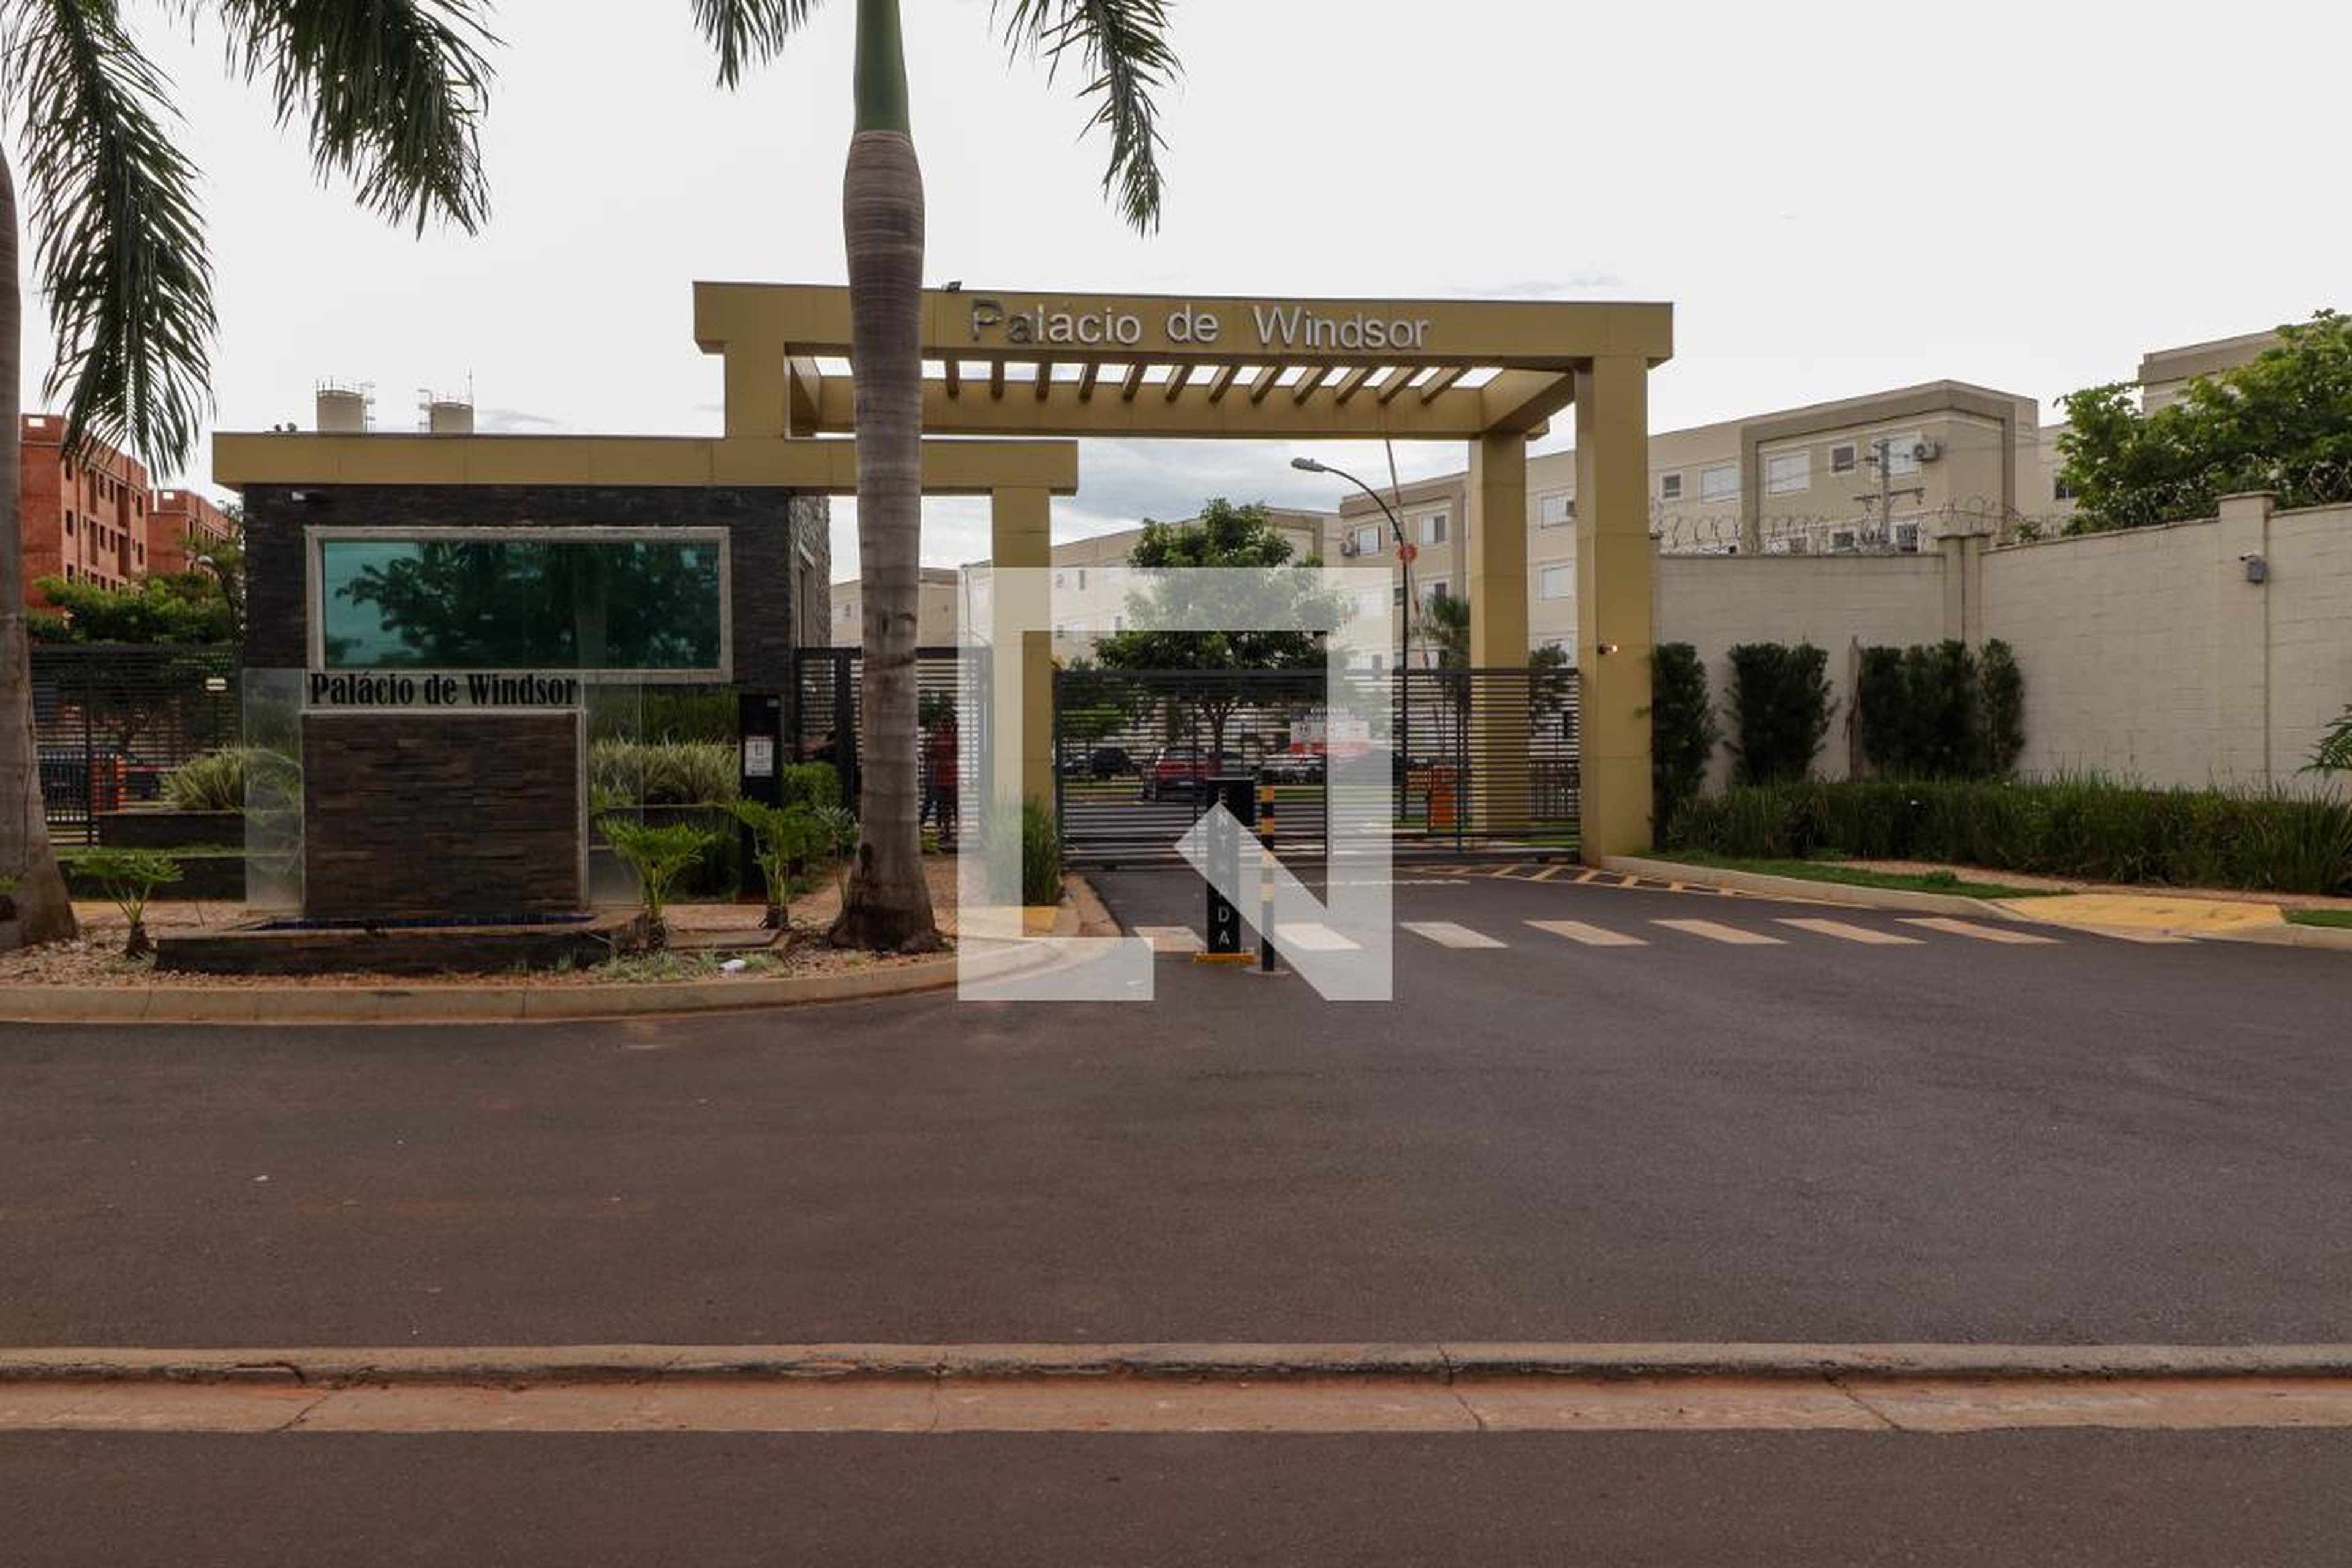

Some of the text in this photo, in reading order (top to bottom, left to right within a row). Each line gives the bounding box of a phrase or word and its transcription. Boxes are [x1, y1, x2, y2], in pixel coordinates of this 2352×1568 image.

[1167, 303, 1219, 342] de
[1253, 305, 1430, 347] Windsor
[310, 671, 578, 705] Palácio de Windsor
